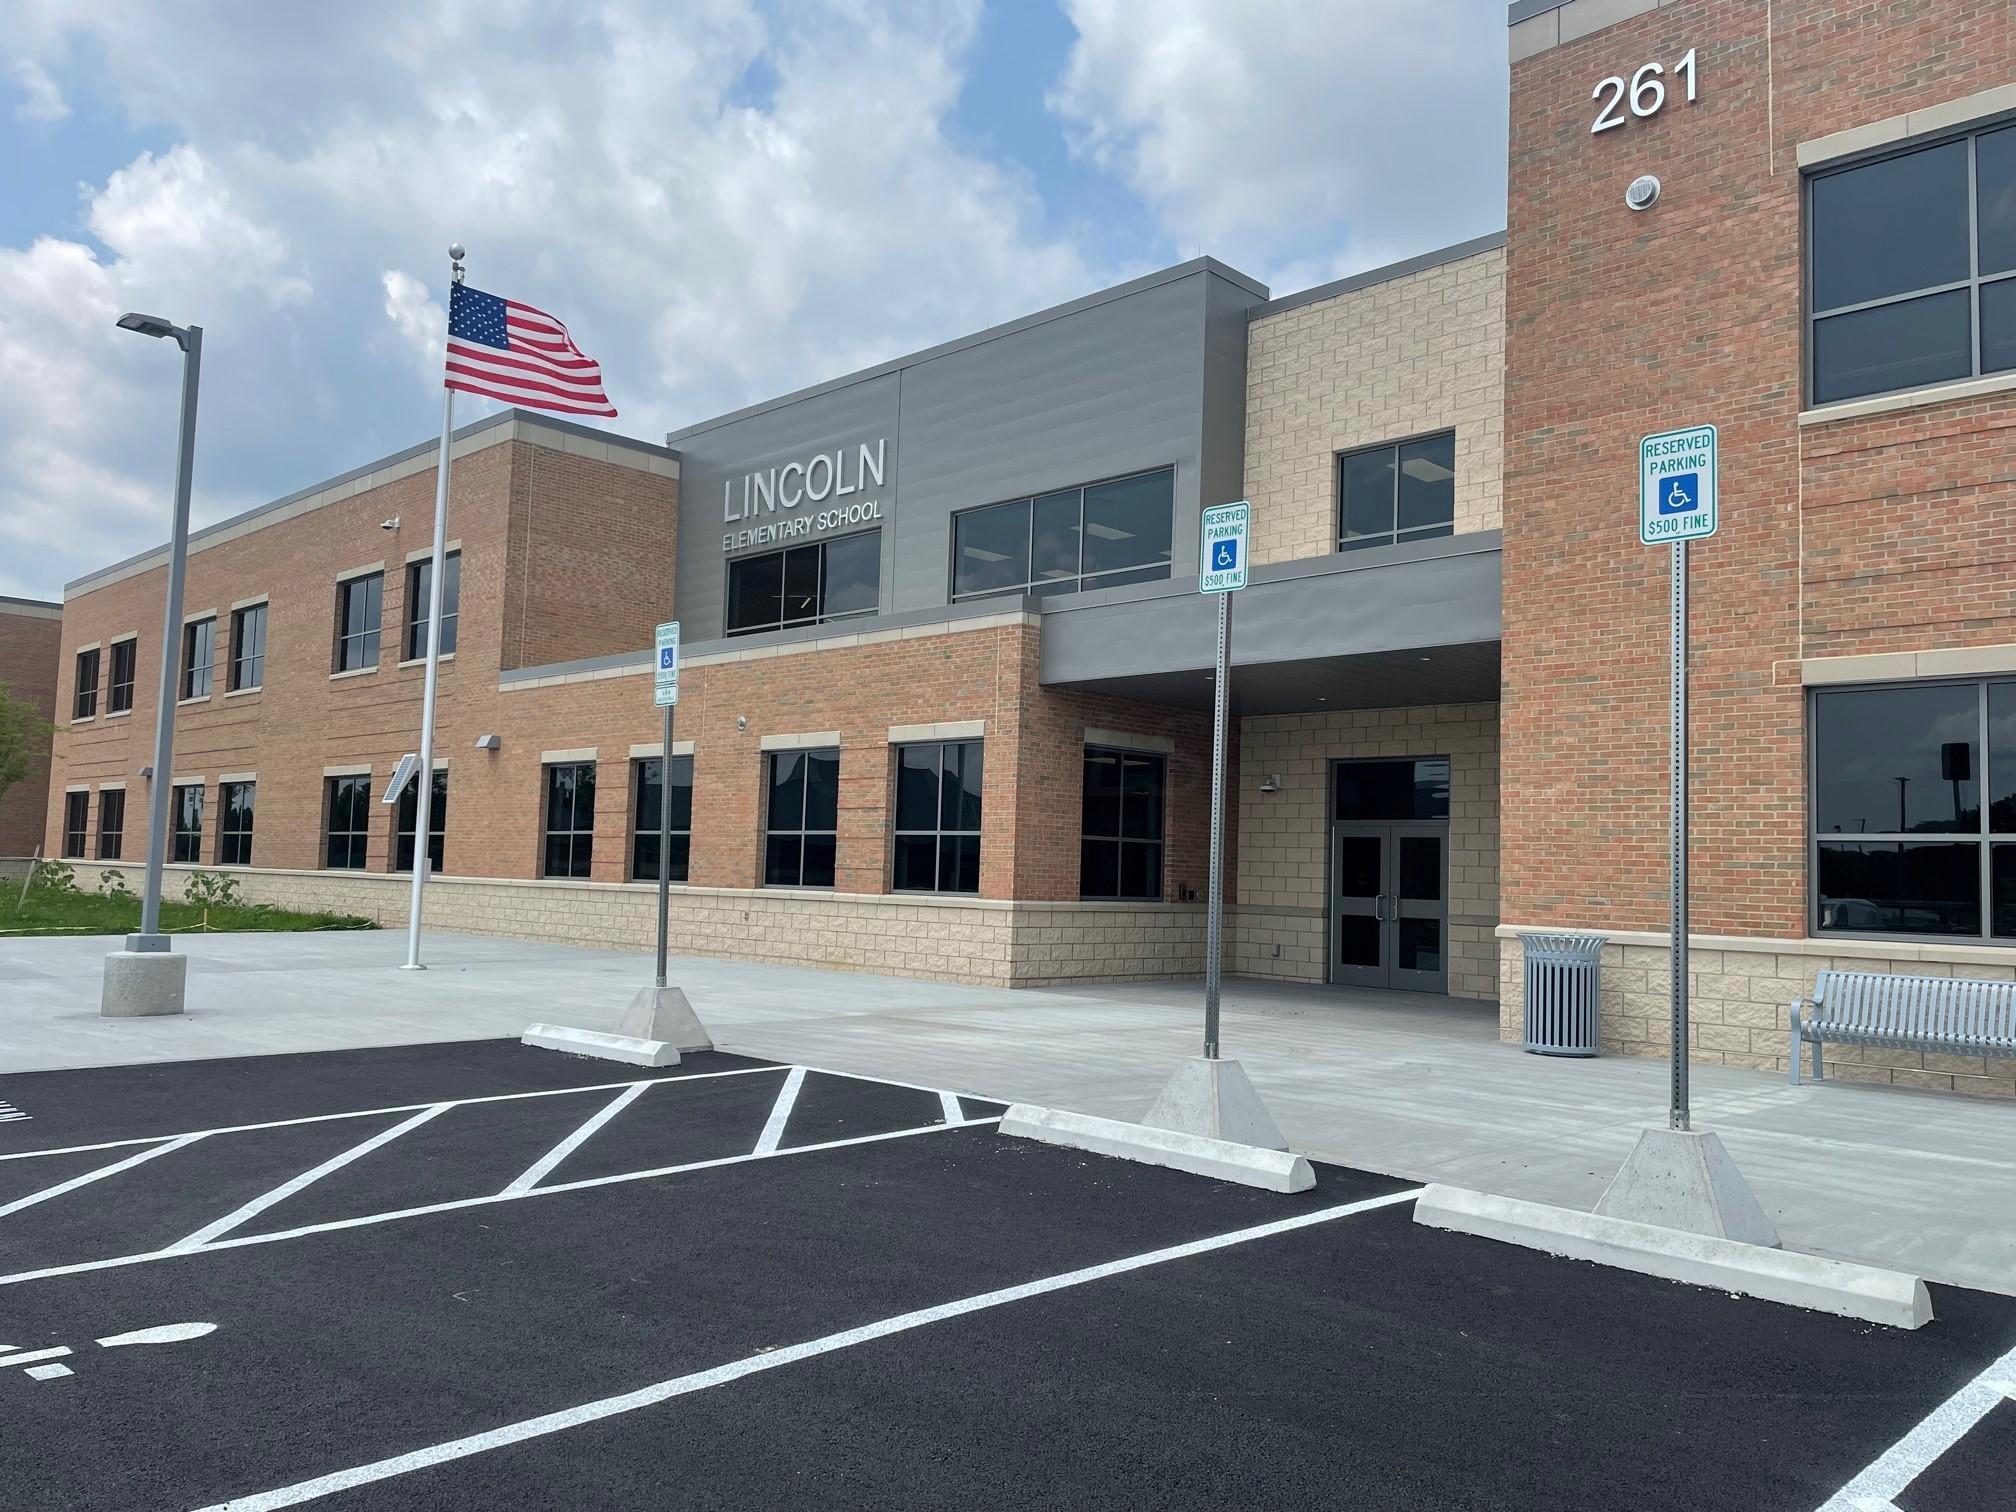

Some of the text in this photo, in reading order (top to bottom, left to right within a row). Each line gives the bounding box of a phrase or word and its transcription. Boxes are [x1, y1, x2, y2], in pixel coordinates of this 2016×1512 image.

[1591, 47, 1696, 133] 261
[1645, 434, 1711, 458] RESERVED
[1650, 453, 1706, 475] PARKING
[724, 438, 887, 523] LINCOLN
[723, 500, 883, 551] ELEMENTARY SCHOOL
[1206, 508, 1247, 526] RESERVED
[1648, 513, 1709, 535] $500 FINE
[1208, 523, 1243, 539] PARKING
[1204, 571, 1242, 586] $500 FINE
